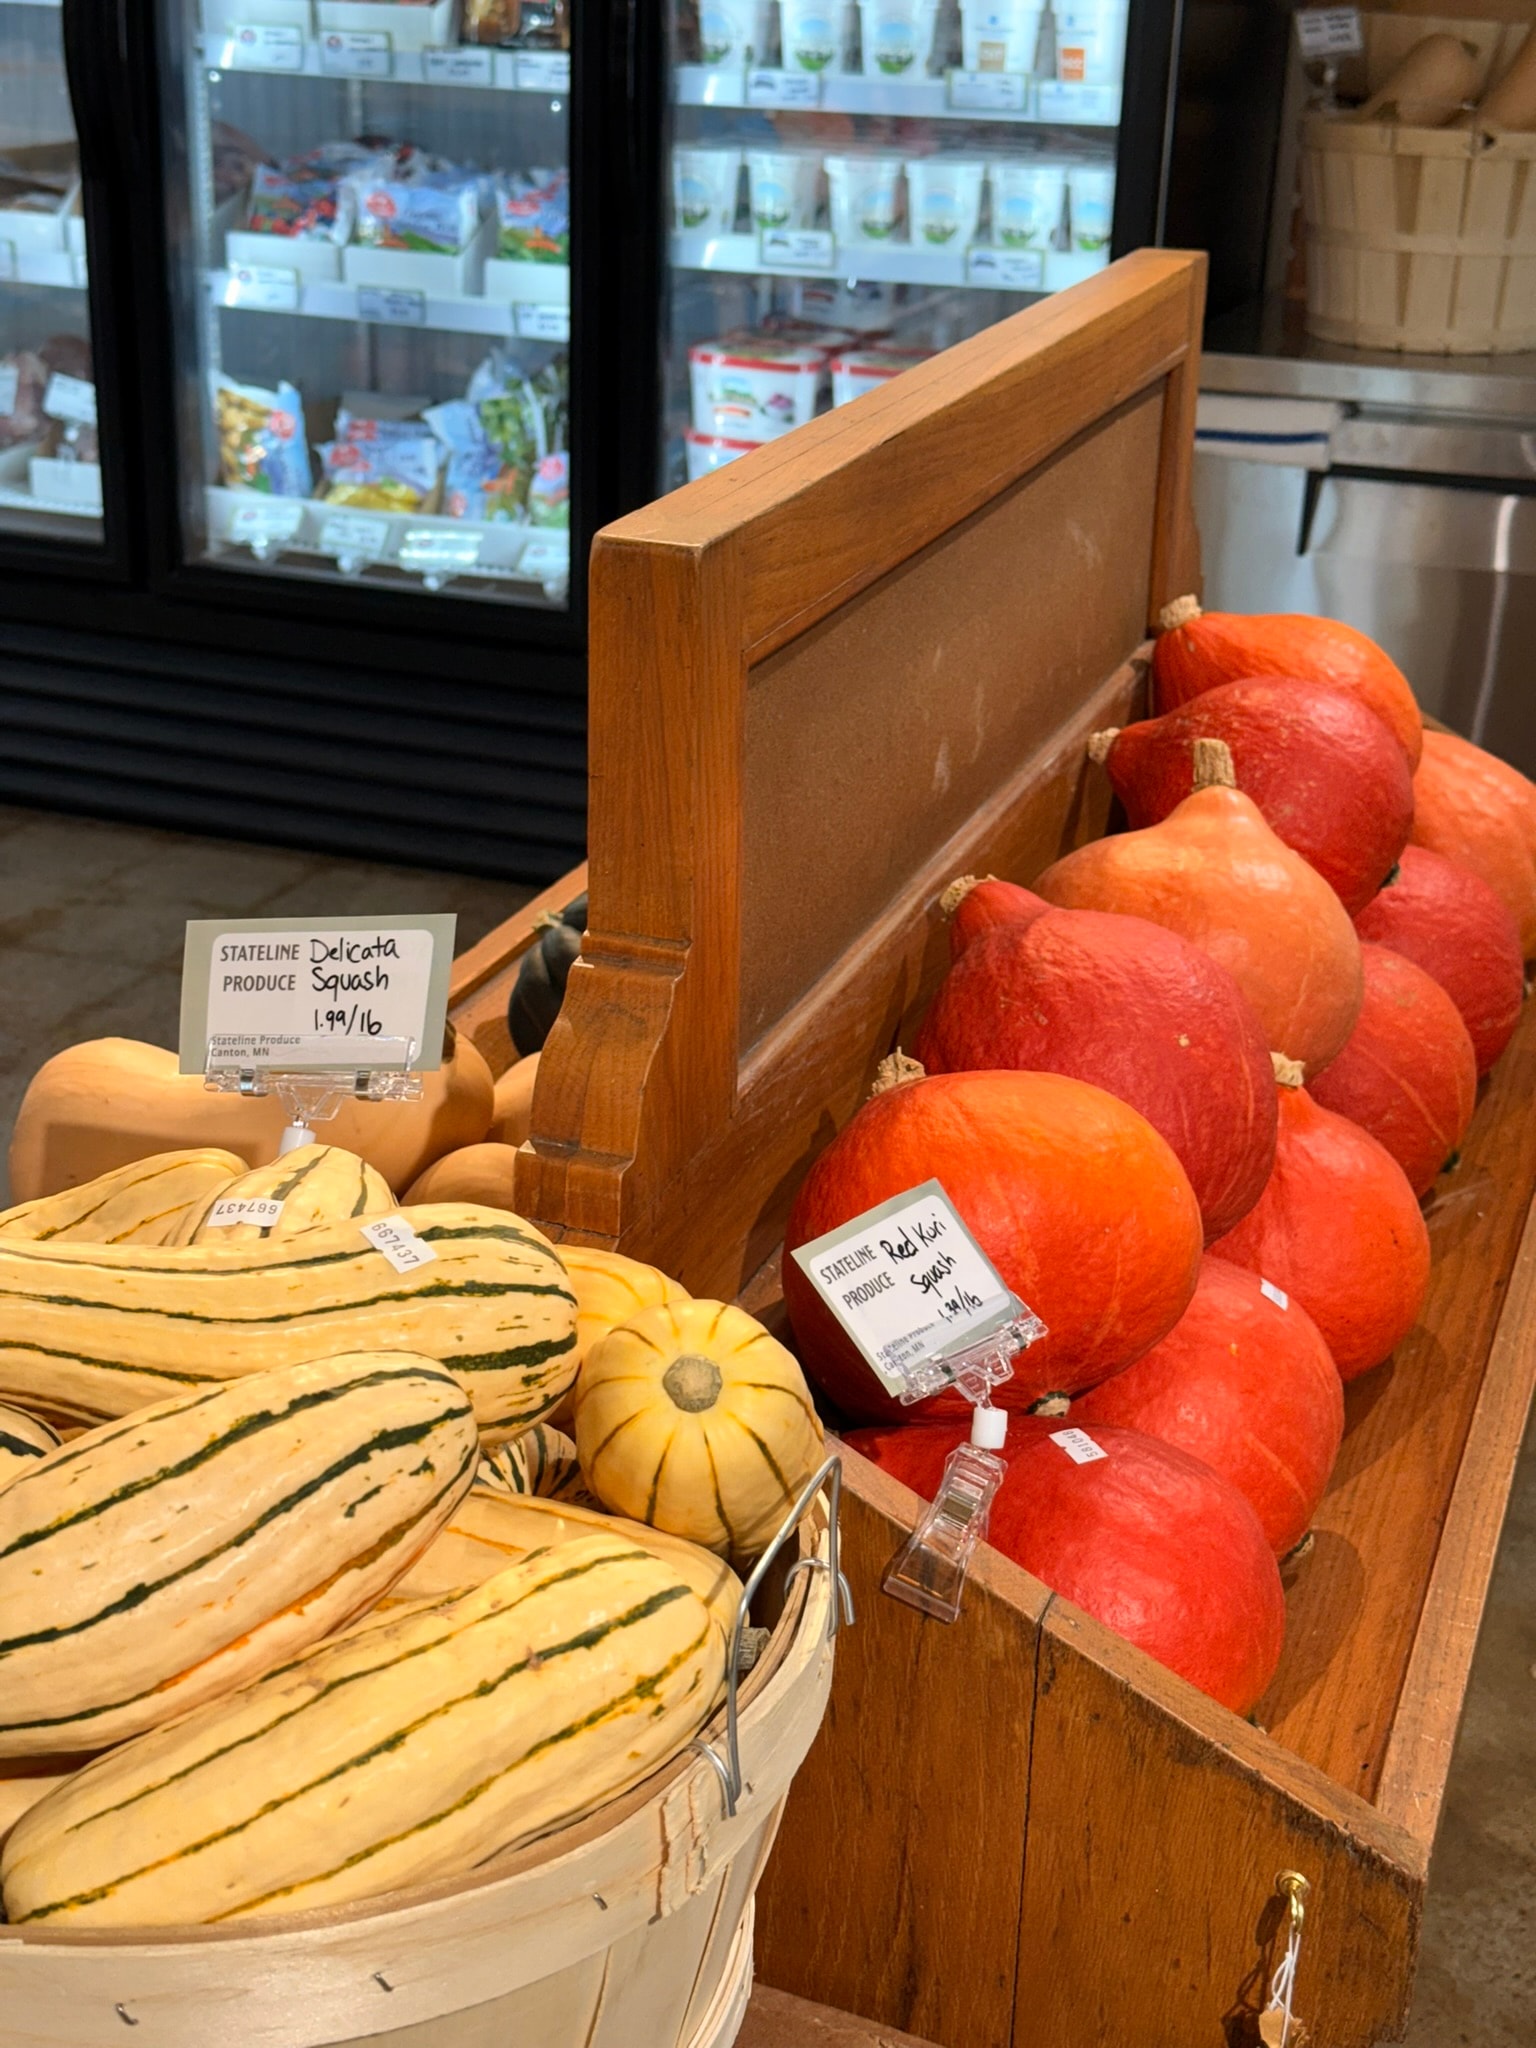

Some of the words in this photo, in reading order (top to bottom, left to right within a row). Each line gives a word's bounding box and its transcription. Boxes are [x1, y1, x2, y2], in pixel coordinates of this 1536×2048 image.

[220, 944, 300, 962] STATELINE
[309, 936, 401, 964] Delicata
[222, 974, 296, 992] PRODUCE
[311, 965, 390, 1002] Squash
[211, 1035, 257, 1046] Stateline
[260, 1034, 301, 1045] Produce
[252, 1048, 270, 1056] MN
[216, 1203, 278, 1215] 667437
[371, 1222, 420, 1264] 667437
[879, 1226, 919, 1265] Red
[911, 1213, 947, 1248] Kuri
[819, 1244, 877, 1285] STATELINE
[910, 1254, 957, 1298] Squash
[841, 1271, 896, 1310] PRODUCE
